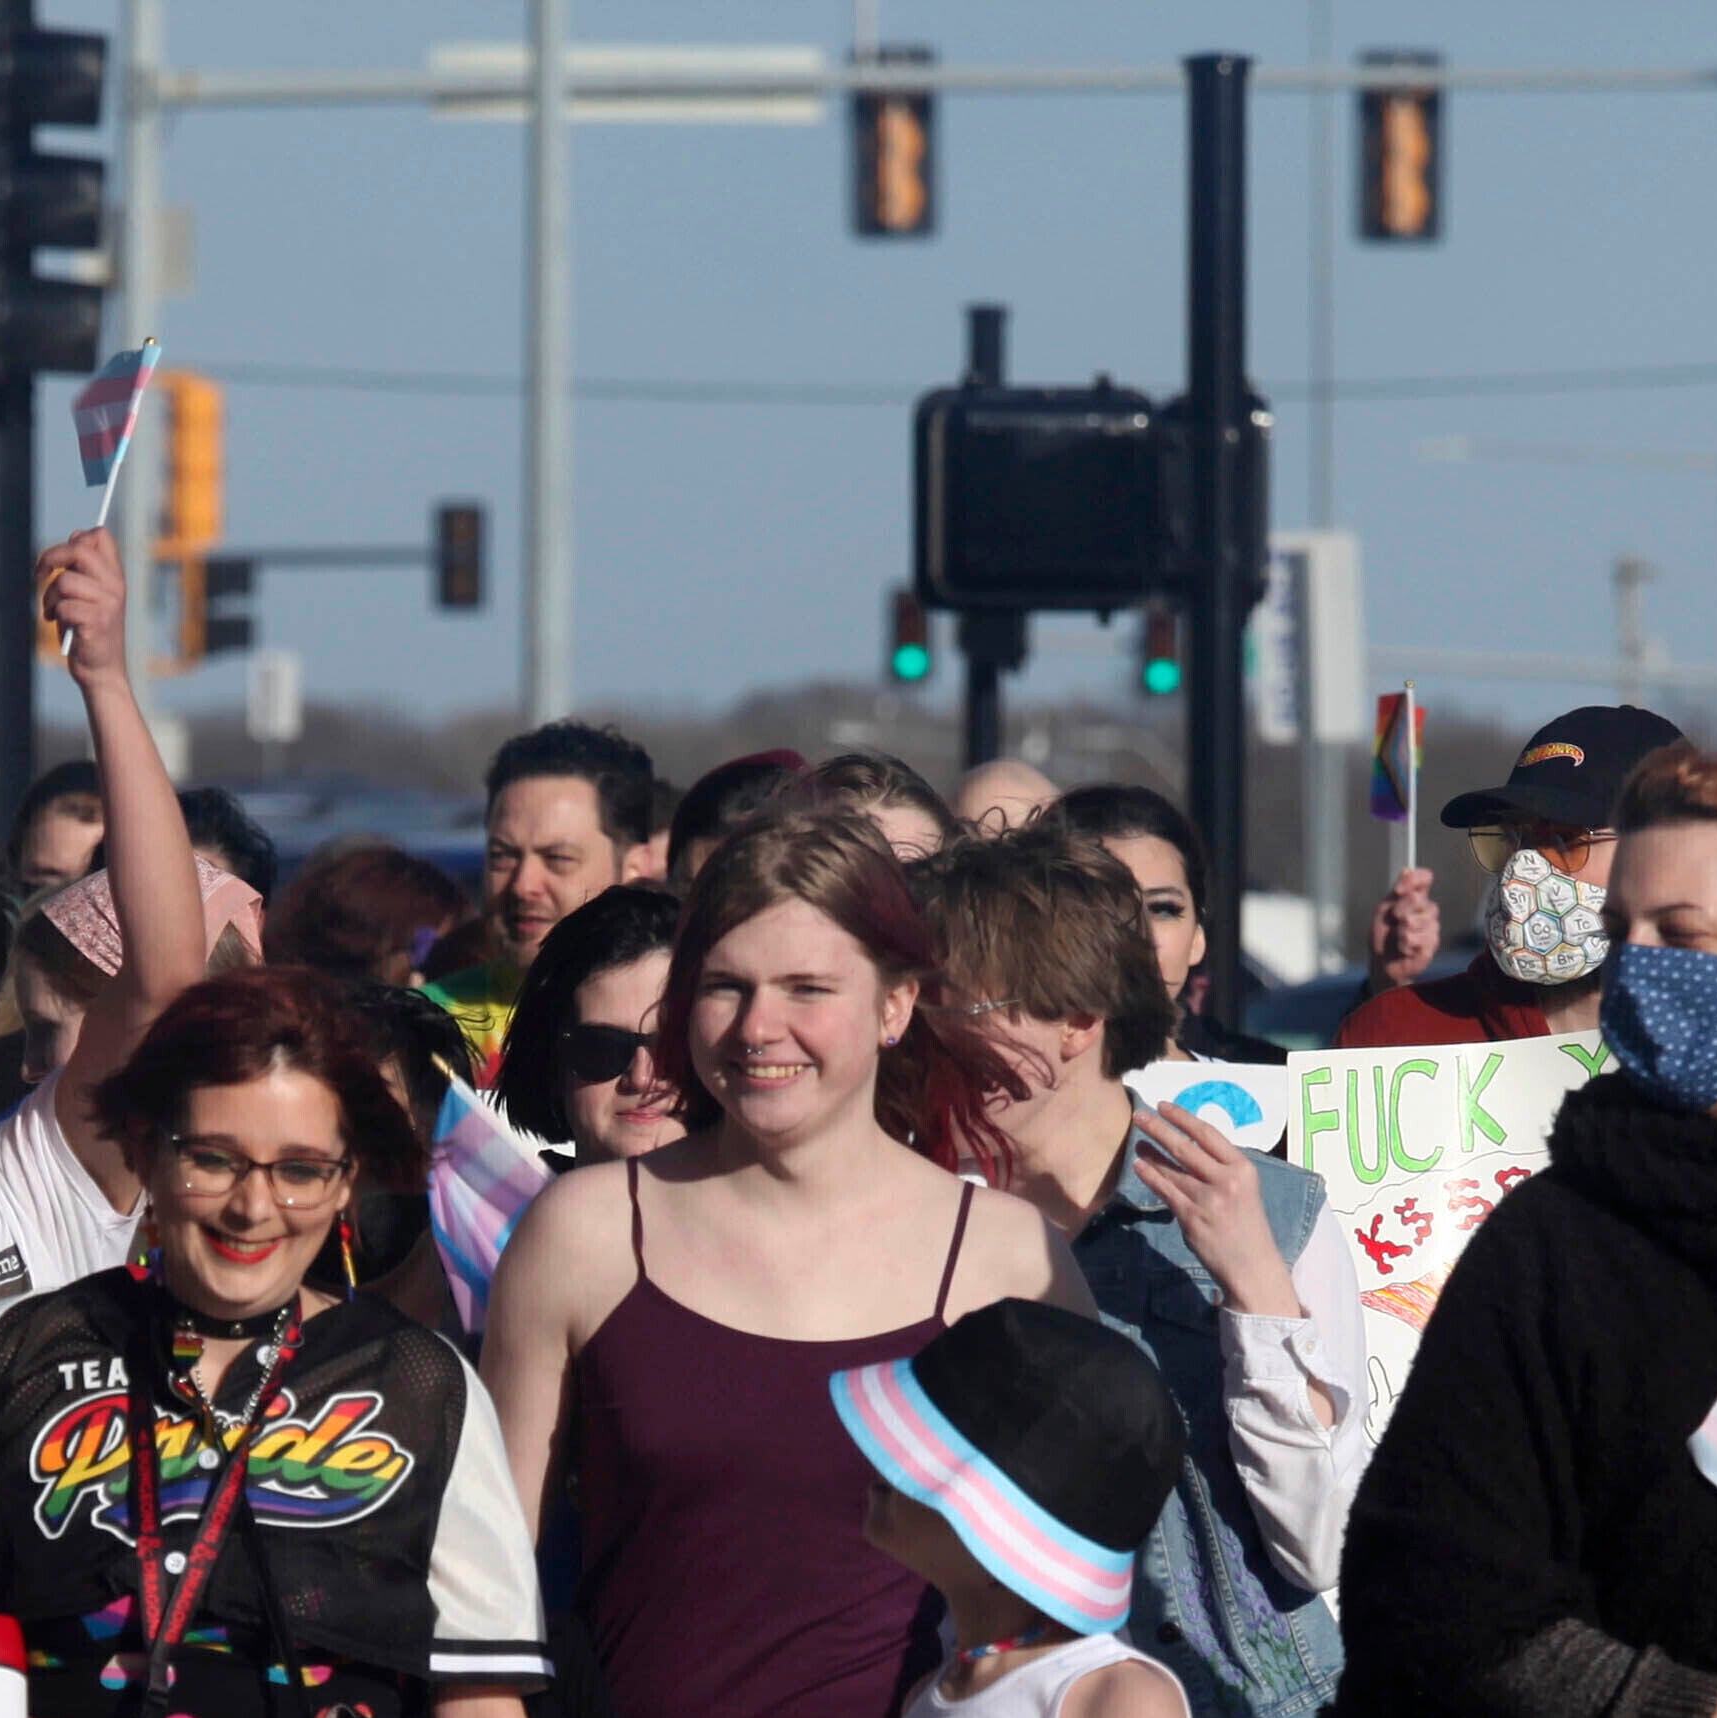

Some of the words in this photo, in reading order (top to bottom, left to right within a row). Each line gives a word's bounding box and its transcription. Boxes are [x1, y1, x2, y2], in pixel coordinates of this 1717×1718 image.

[1532, 922, 1551, 936] Co
[1574, 919, 1590, 930] Tc
[1301, 1053, 1507, 1184] FUCK
[58, 1357, 129, 1391] TEA
[30, 1389, 415, 1546] Pride
